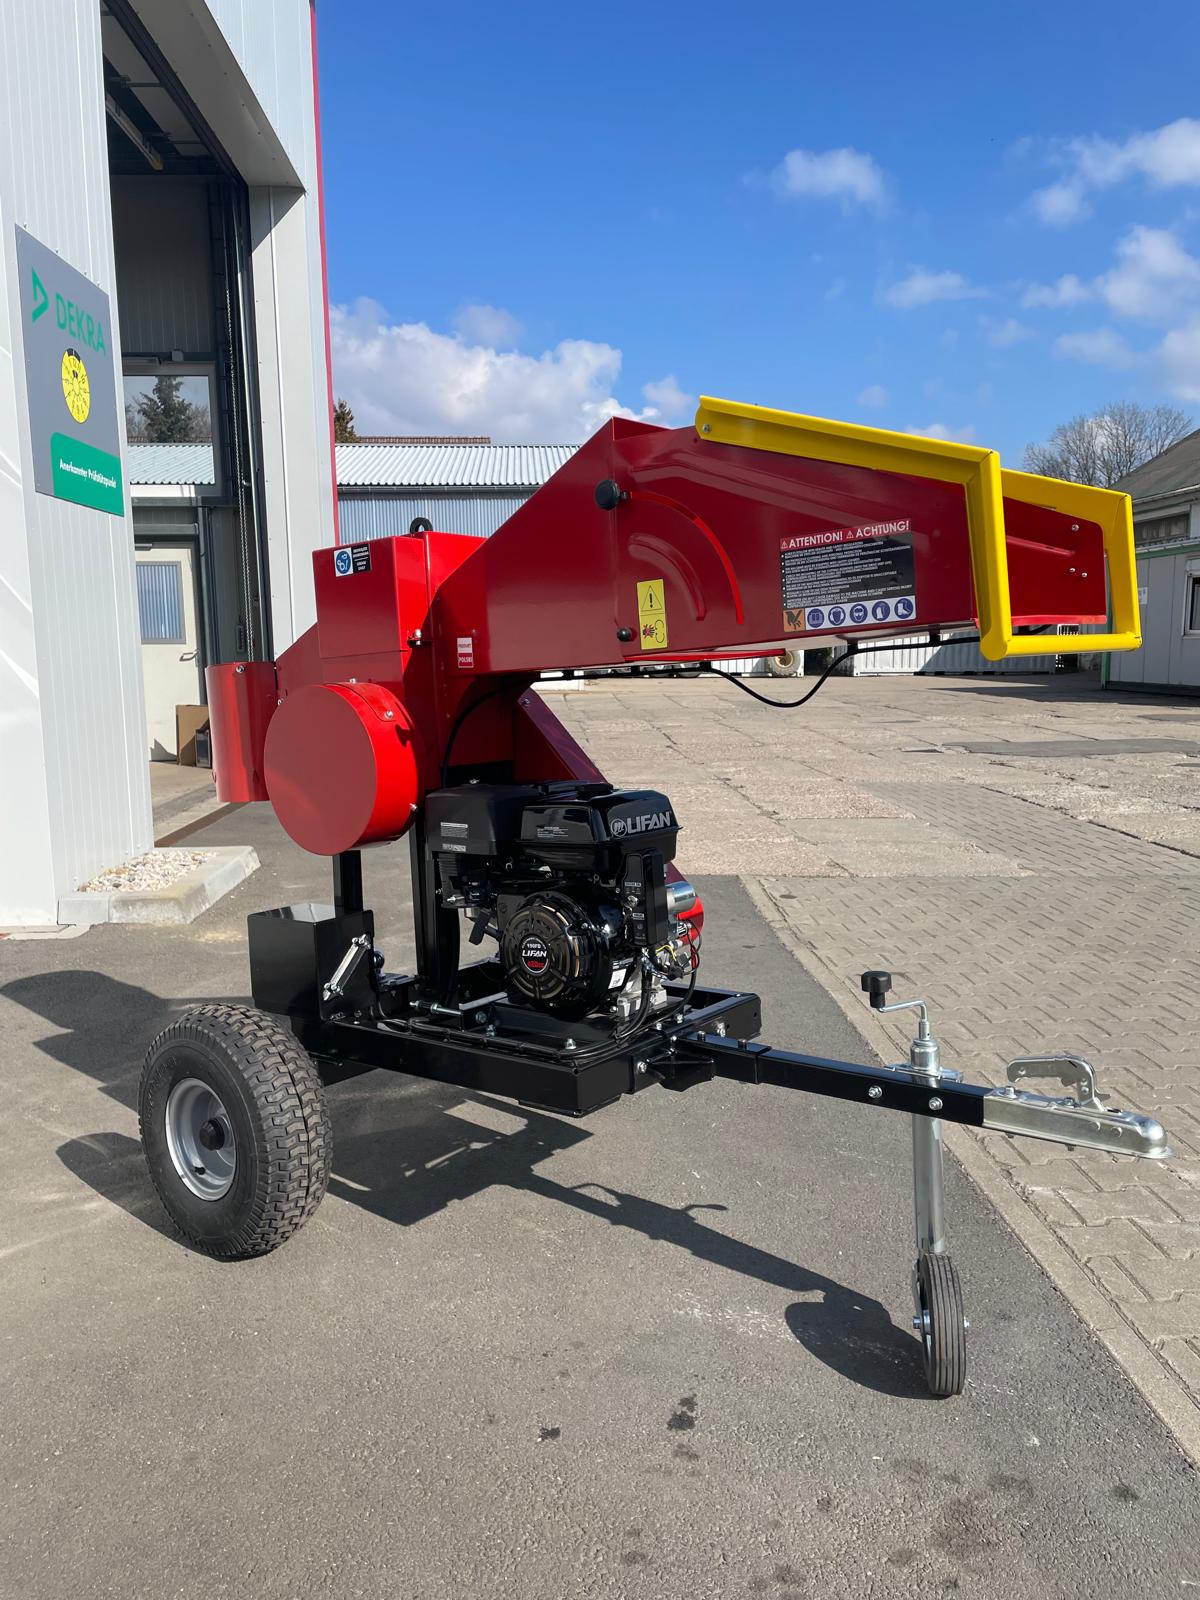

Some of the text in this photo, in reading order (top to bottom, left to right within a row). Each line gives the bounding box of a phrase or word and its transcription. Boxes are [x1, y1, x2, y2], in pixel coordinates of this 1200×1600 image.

[55, 292, 106, 356] DEKRA
[59, 458, 88, 478] Anerkannter
[788, 520, 910, 548] ATTENTION! ACHTUNG!
[627, 811, 671, 834] LIFAN
[522, 949, 547, 957] LIFAN
